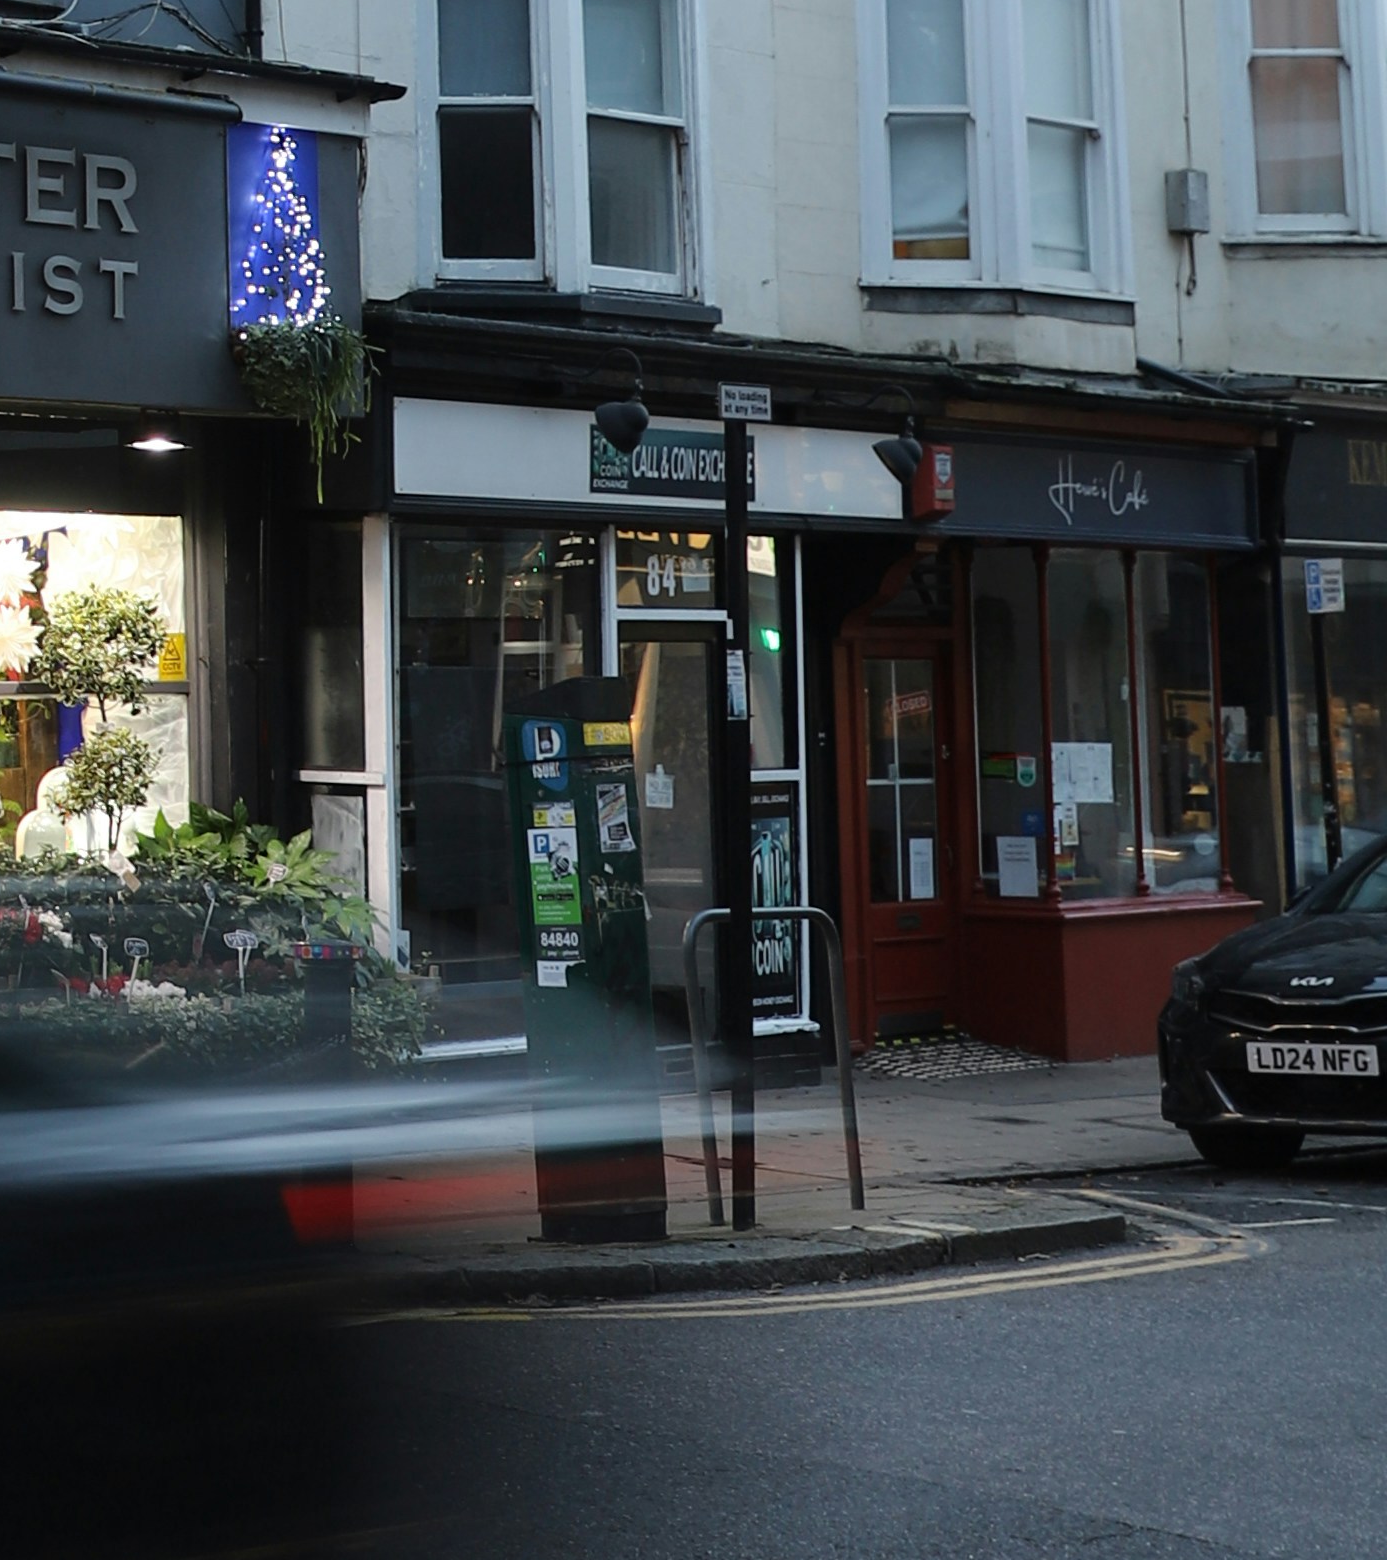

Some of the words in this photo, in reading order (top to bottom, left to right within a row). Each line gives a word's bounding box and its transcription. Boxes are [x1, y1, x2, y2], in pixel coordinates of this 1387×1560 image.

[724, 403, 733, 413] at
[735, 405, 748, 417] any
[751, 405, 768, 416] time
[725, 390, 736, 400] No
[738, 391, 768, 404] loading
[632, 445, 659, 478] CALL
[671, 446, 698, 481] COIN
[699, 449, 753, 485] EXCHE
[647, 554, 676, 598] 84
[540, 932, 579, 947] 84840
[755, 939, 784, 977] COIN
[1256, 1046, 1316, 1071] LD24
[1322, 1048, 1370, 1073] NFG
